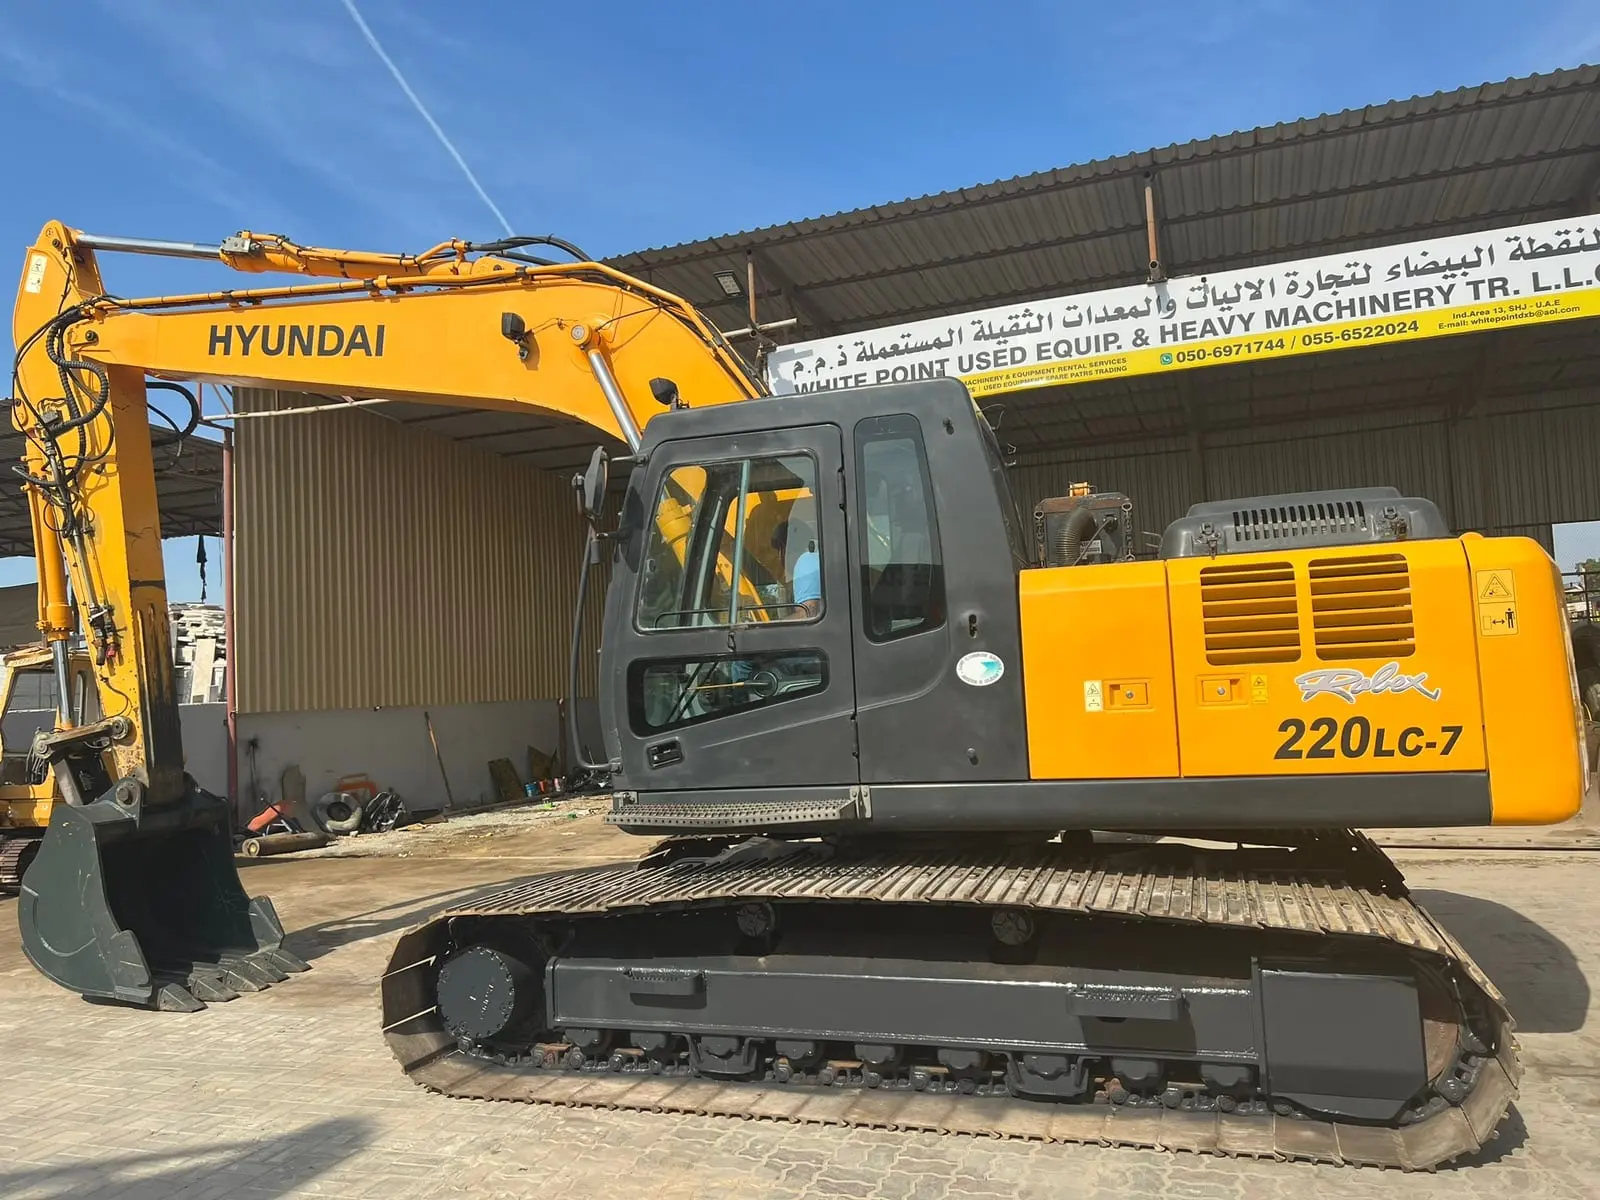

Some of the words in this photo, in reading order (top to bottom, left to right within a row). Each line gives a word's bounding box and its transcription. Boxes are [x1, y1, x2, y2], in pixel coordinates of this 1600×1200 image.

[1284, 261, 1372, 298] لتجارة
[1384, 243, 1495, 282] البيضاء
[970, 307, 1053, 345] الثقيلة
[1062, 295, 1177, 329] والمعدات
[1438, 320, 1469, 330] E-mail:
[1471, 305, 1581, 325] whitepointdxb@aol.com
[1452, 308, 1490, 319] Ind.Area
[1508, 304, 1527, 312] SHJ
[1535, 299, 1561, 309] U.A.E
[208, 325, 385, 356] HYUNDAI
[853, 326, 963, 362] المستعملة
[876, 358, 950, 384] POINT
[958, 346, 1027, 373] USED
[1036, 332, 1122, 361] EQUIP.
[1132, 328, 1151, 348] &
[1160, 312, 1255, 344] HEAVY
[1265, 283, 1456, 329] MACHINERY
[1466, 276, 1520, 300] TR.
[1176, 337, 1286, 363] 050-6971744
[1302, 320, 1419, 346] 055-6522024
[983, 383, 1002, 391] USED
[1003, 376, 1045, 388] EQUIPMENT
[1045, 370, 1070, 381] SPARE
[1070, 368, 1093, 378] PATRS
[1095, 365, 1128, 375] TRADING
[1012, 367, 1056, 379] EQUIPMENT
[1058, 363, 1087, 373] RENTAL
[1089, 357, 1127, 368] SERVICES
[1294, 661, 1442, 704] Robex
